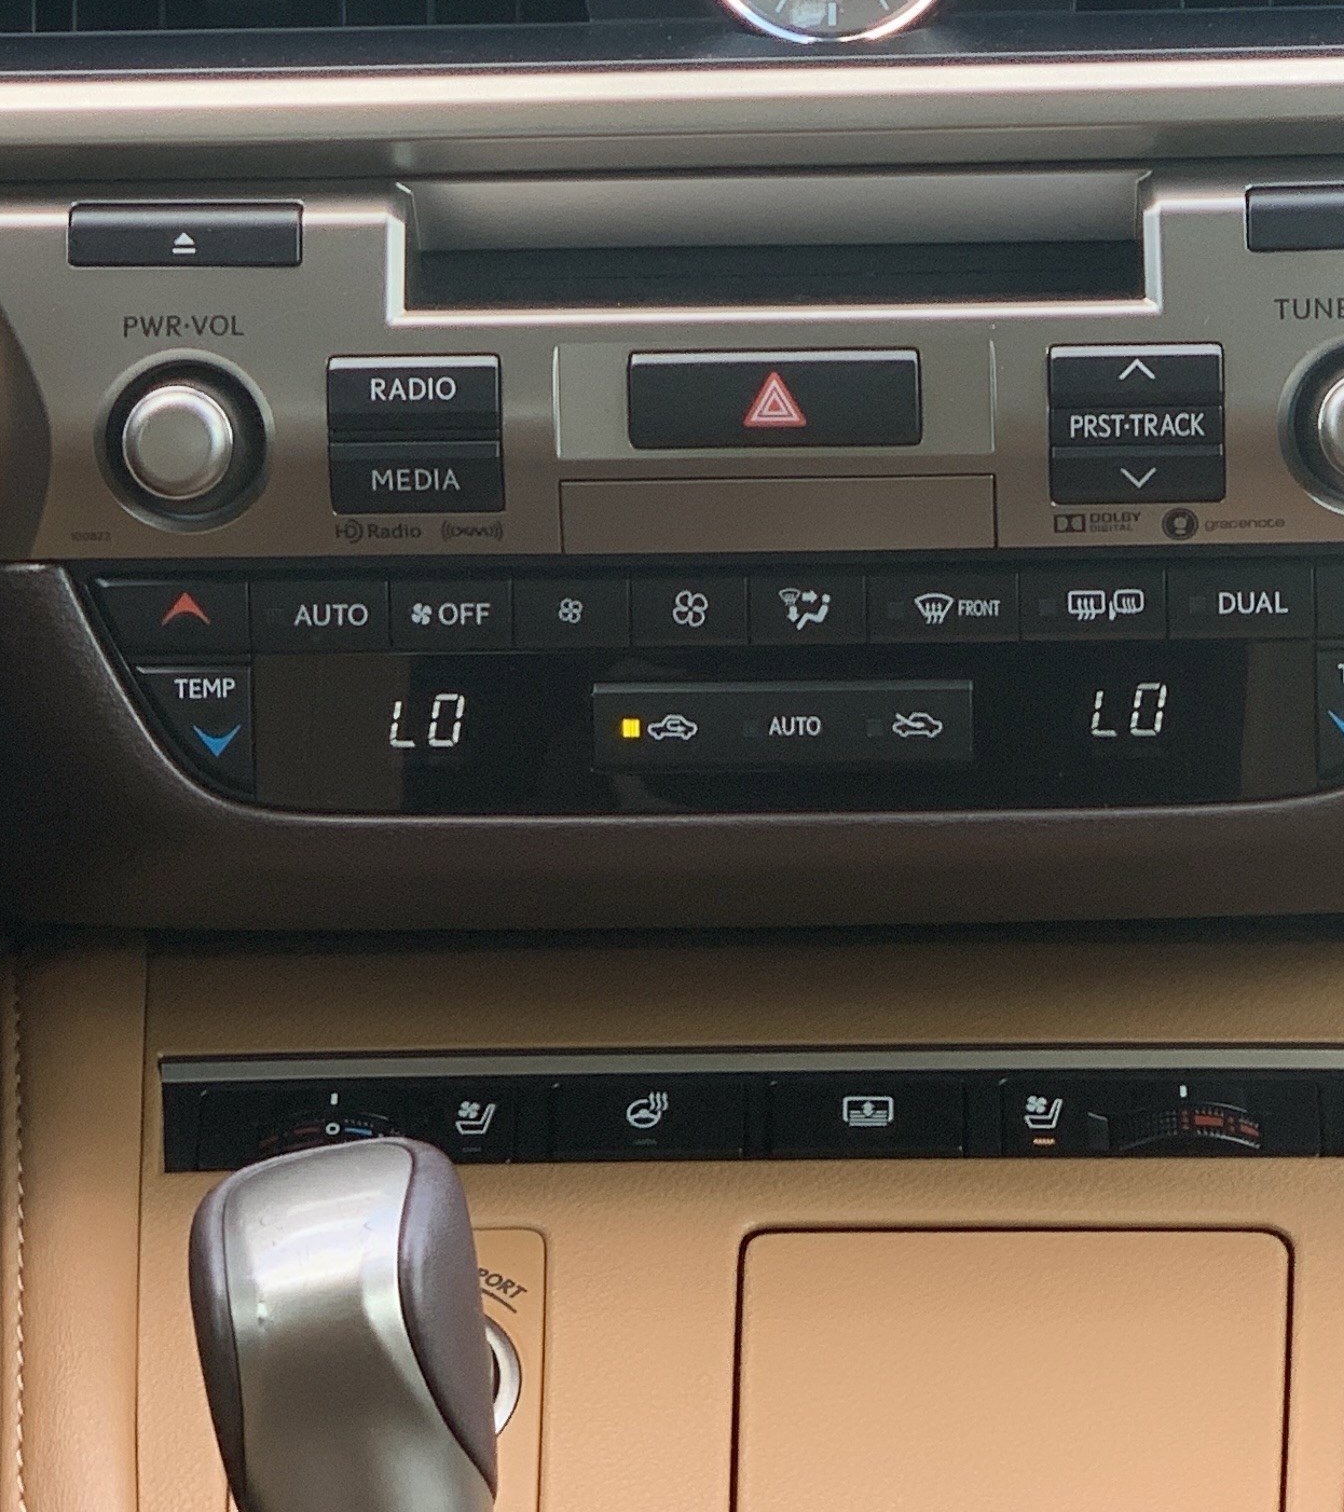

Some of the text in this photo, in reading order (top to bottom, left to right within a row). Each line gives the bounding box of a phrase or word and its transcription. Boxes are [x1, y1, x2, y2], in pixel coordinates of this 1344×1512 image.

[370, 377, 457, 402] RADIO
[371, 468, 461, 492] MEDIA
[1089, 512, 1141, 524] DOLBY
[1205, 517, 1286, 532] gracenote
[367, 523, 422, 539] Radio
[294, 602, 369, 627] AUTO
[438, 602, 491, 627] OFF
[957, 597, 1001, 619] FRONT
[1217, 591, 1289, 615] DUAL
[174, 678, 236, 700] TEMP
[389, 693, 465, 748] LO
[1091, 682, 1167, 737] LO
[768, 716, 822, 738] AUTO
